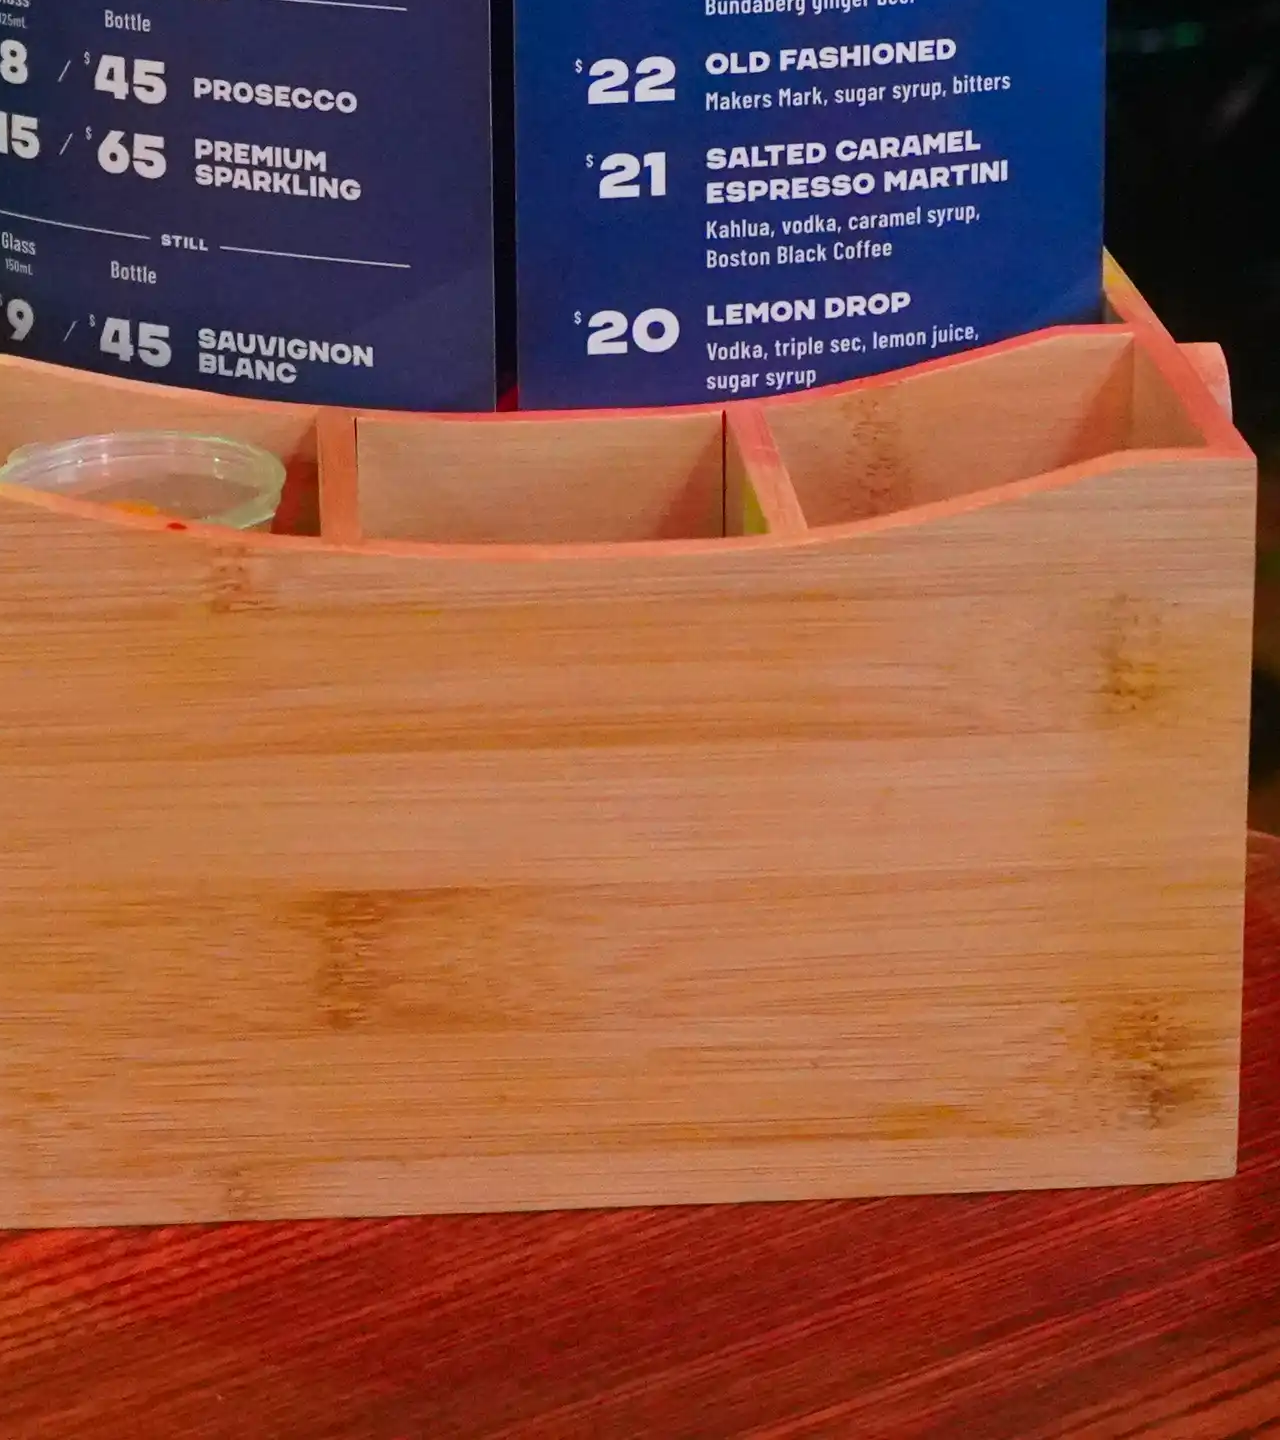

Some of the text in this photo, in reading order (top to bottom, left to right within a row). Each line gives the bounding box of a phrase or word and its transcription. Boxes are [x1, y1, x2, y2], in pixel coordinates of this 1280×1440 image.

[105, 10, 150, 32] Bottle
[84, 52, 166, 104] $45
[194, 78, 357, 113] PROSECCO
[576, 39, 956, 104] $22 OLD FASHIONED
[706, 75, 1010, 110] Makers Mark, sugar syrup, bitters
[86, 127, 166, 179] $65
[195, 139, 326, 172] PREMIUM
[586, 130, 981, 198] $21 SALTED CARAMEL
[196, 164, 361, 200] SPARKLING
[707, 160, 1008, 203] ESPRESSO MARTINI
[707, 206, 979, 239] Kahlua, vodka, caramel syrup,
[2, 232, 156, 284] Glass Bottle
[161, 234, 208, 251] STILL
[707, 240, 892, 268] Boston Black Coffee
[90, 314, 171, 367] $45
[199, 329, 373, 367] SAUVIGNON
[574, 292, 910, 355] $20 LEMON DROP
[707, 324, 978, 360] Vodka, triple sec, lemon juice,
[199, 353, 296, 383] BLANC
[707, 370, 816, 392] sugar syrup
